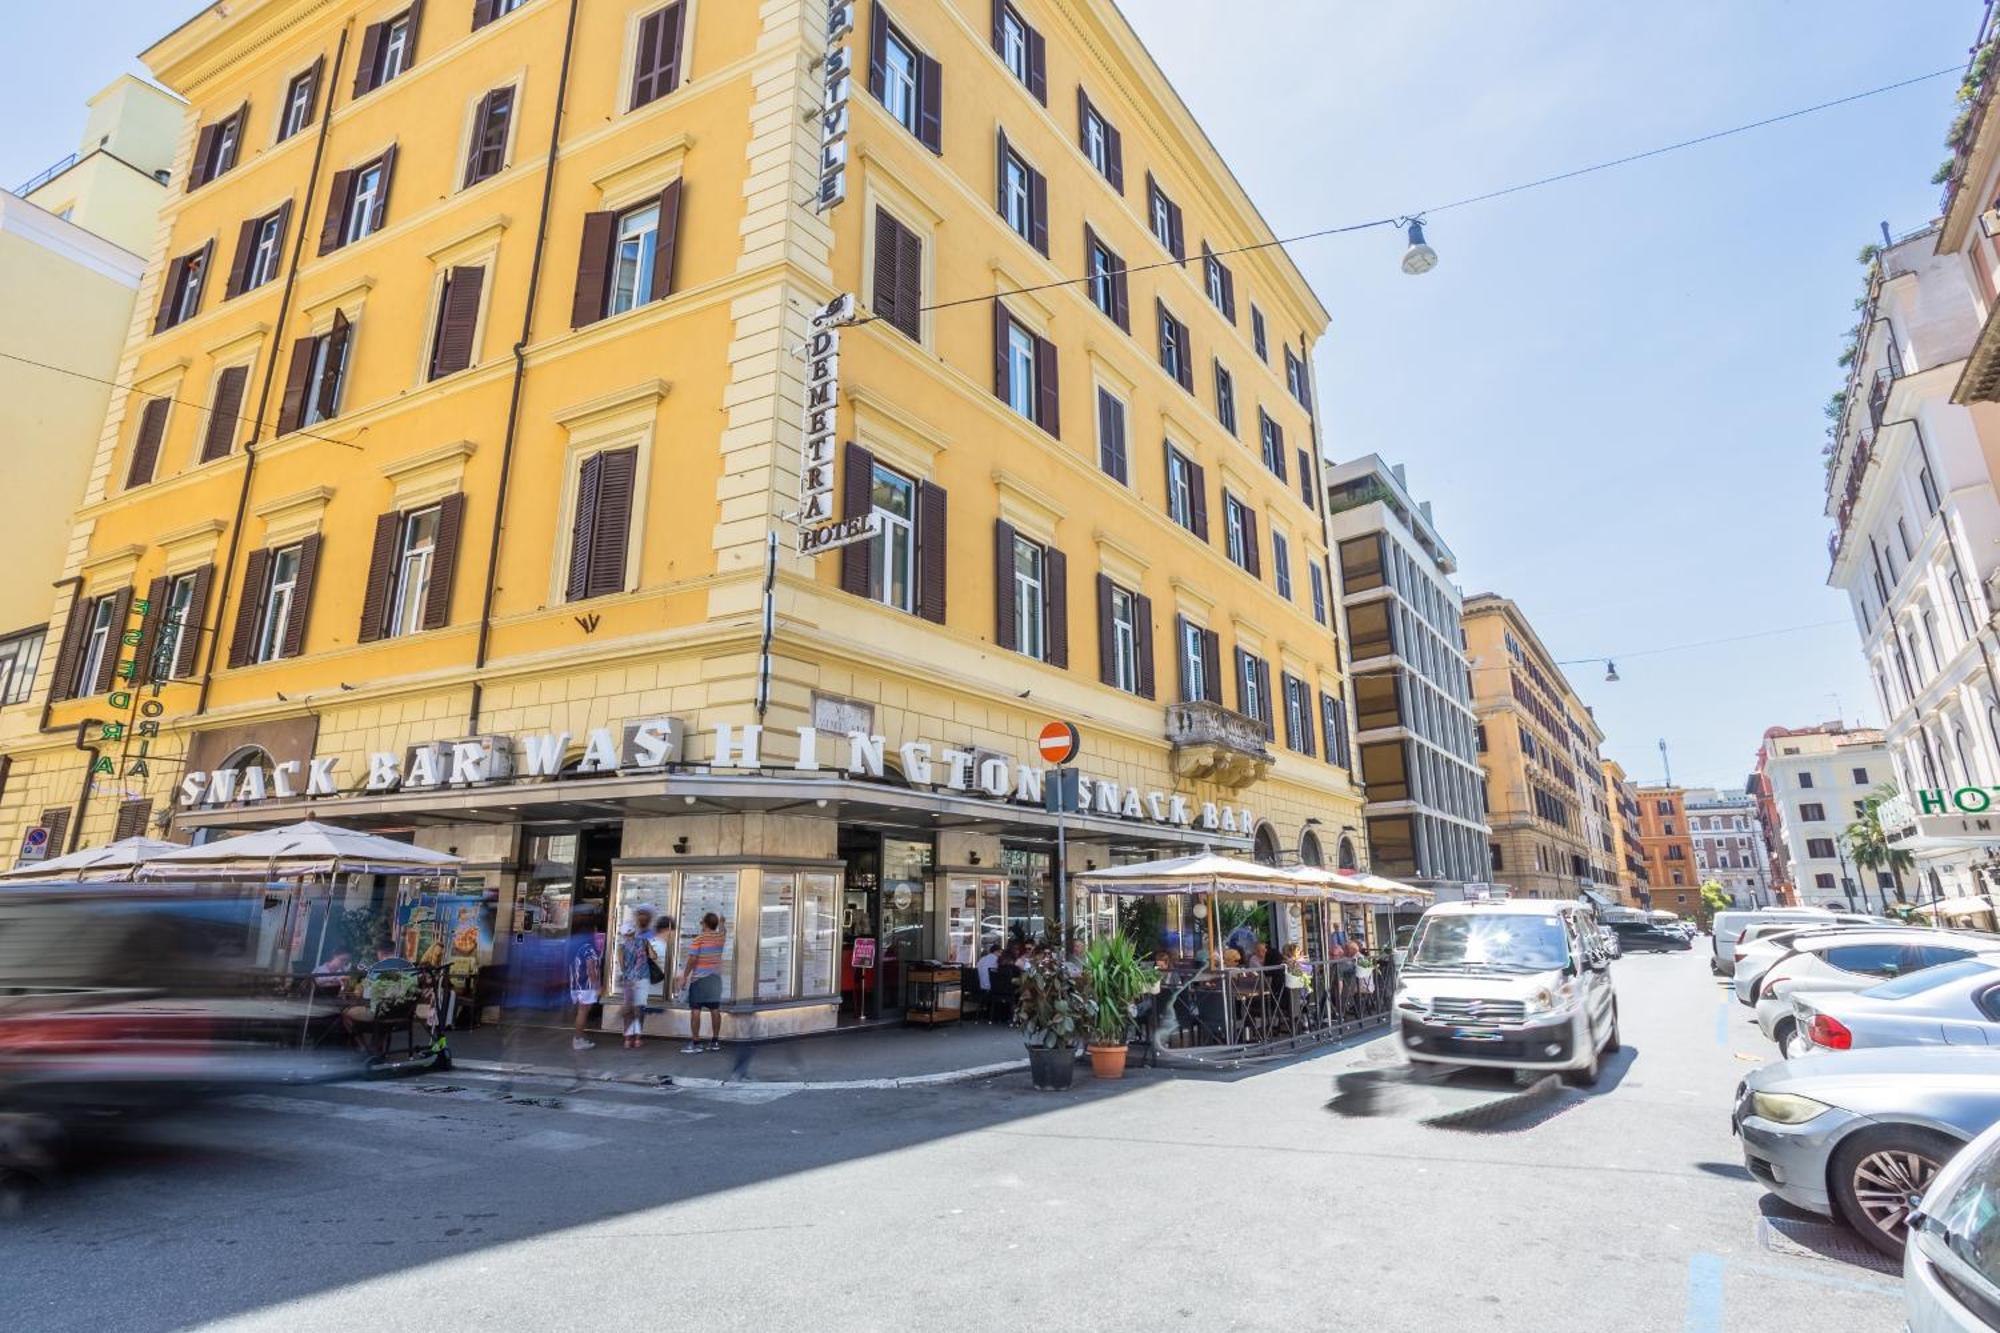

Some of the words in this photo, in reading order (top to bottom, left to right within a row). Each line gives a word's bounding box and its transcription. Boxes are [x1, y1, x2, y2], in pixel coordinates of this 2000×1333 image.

[821, 0, 846, 203] ASTYLE
[807, 334, 831, 519] DEMETRA
[802, 515, 877, 551] HOTEL
[181, 757, 338, 806] SNACK
[366, 743, 487, 790] BAR
[523, 718, 1042, 801] WASHINGTON
[1078, 775, 1188, 825] SNACK
[1203, 801, 1254, 834] BAR
[1919, 786, 2000, 814] HO
